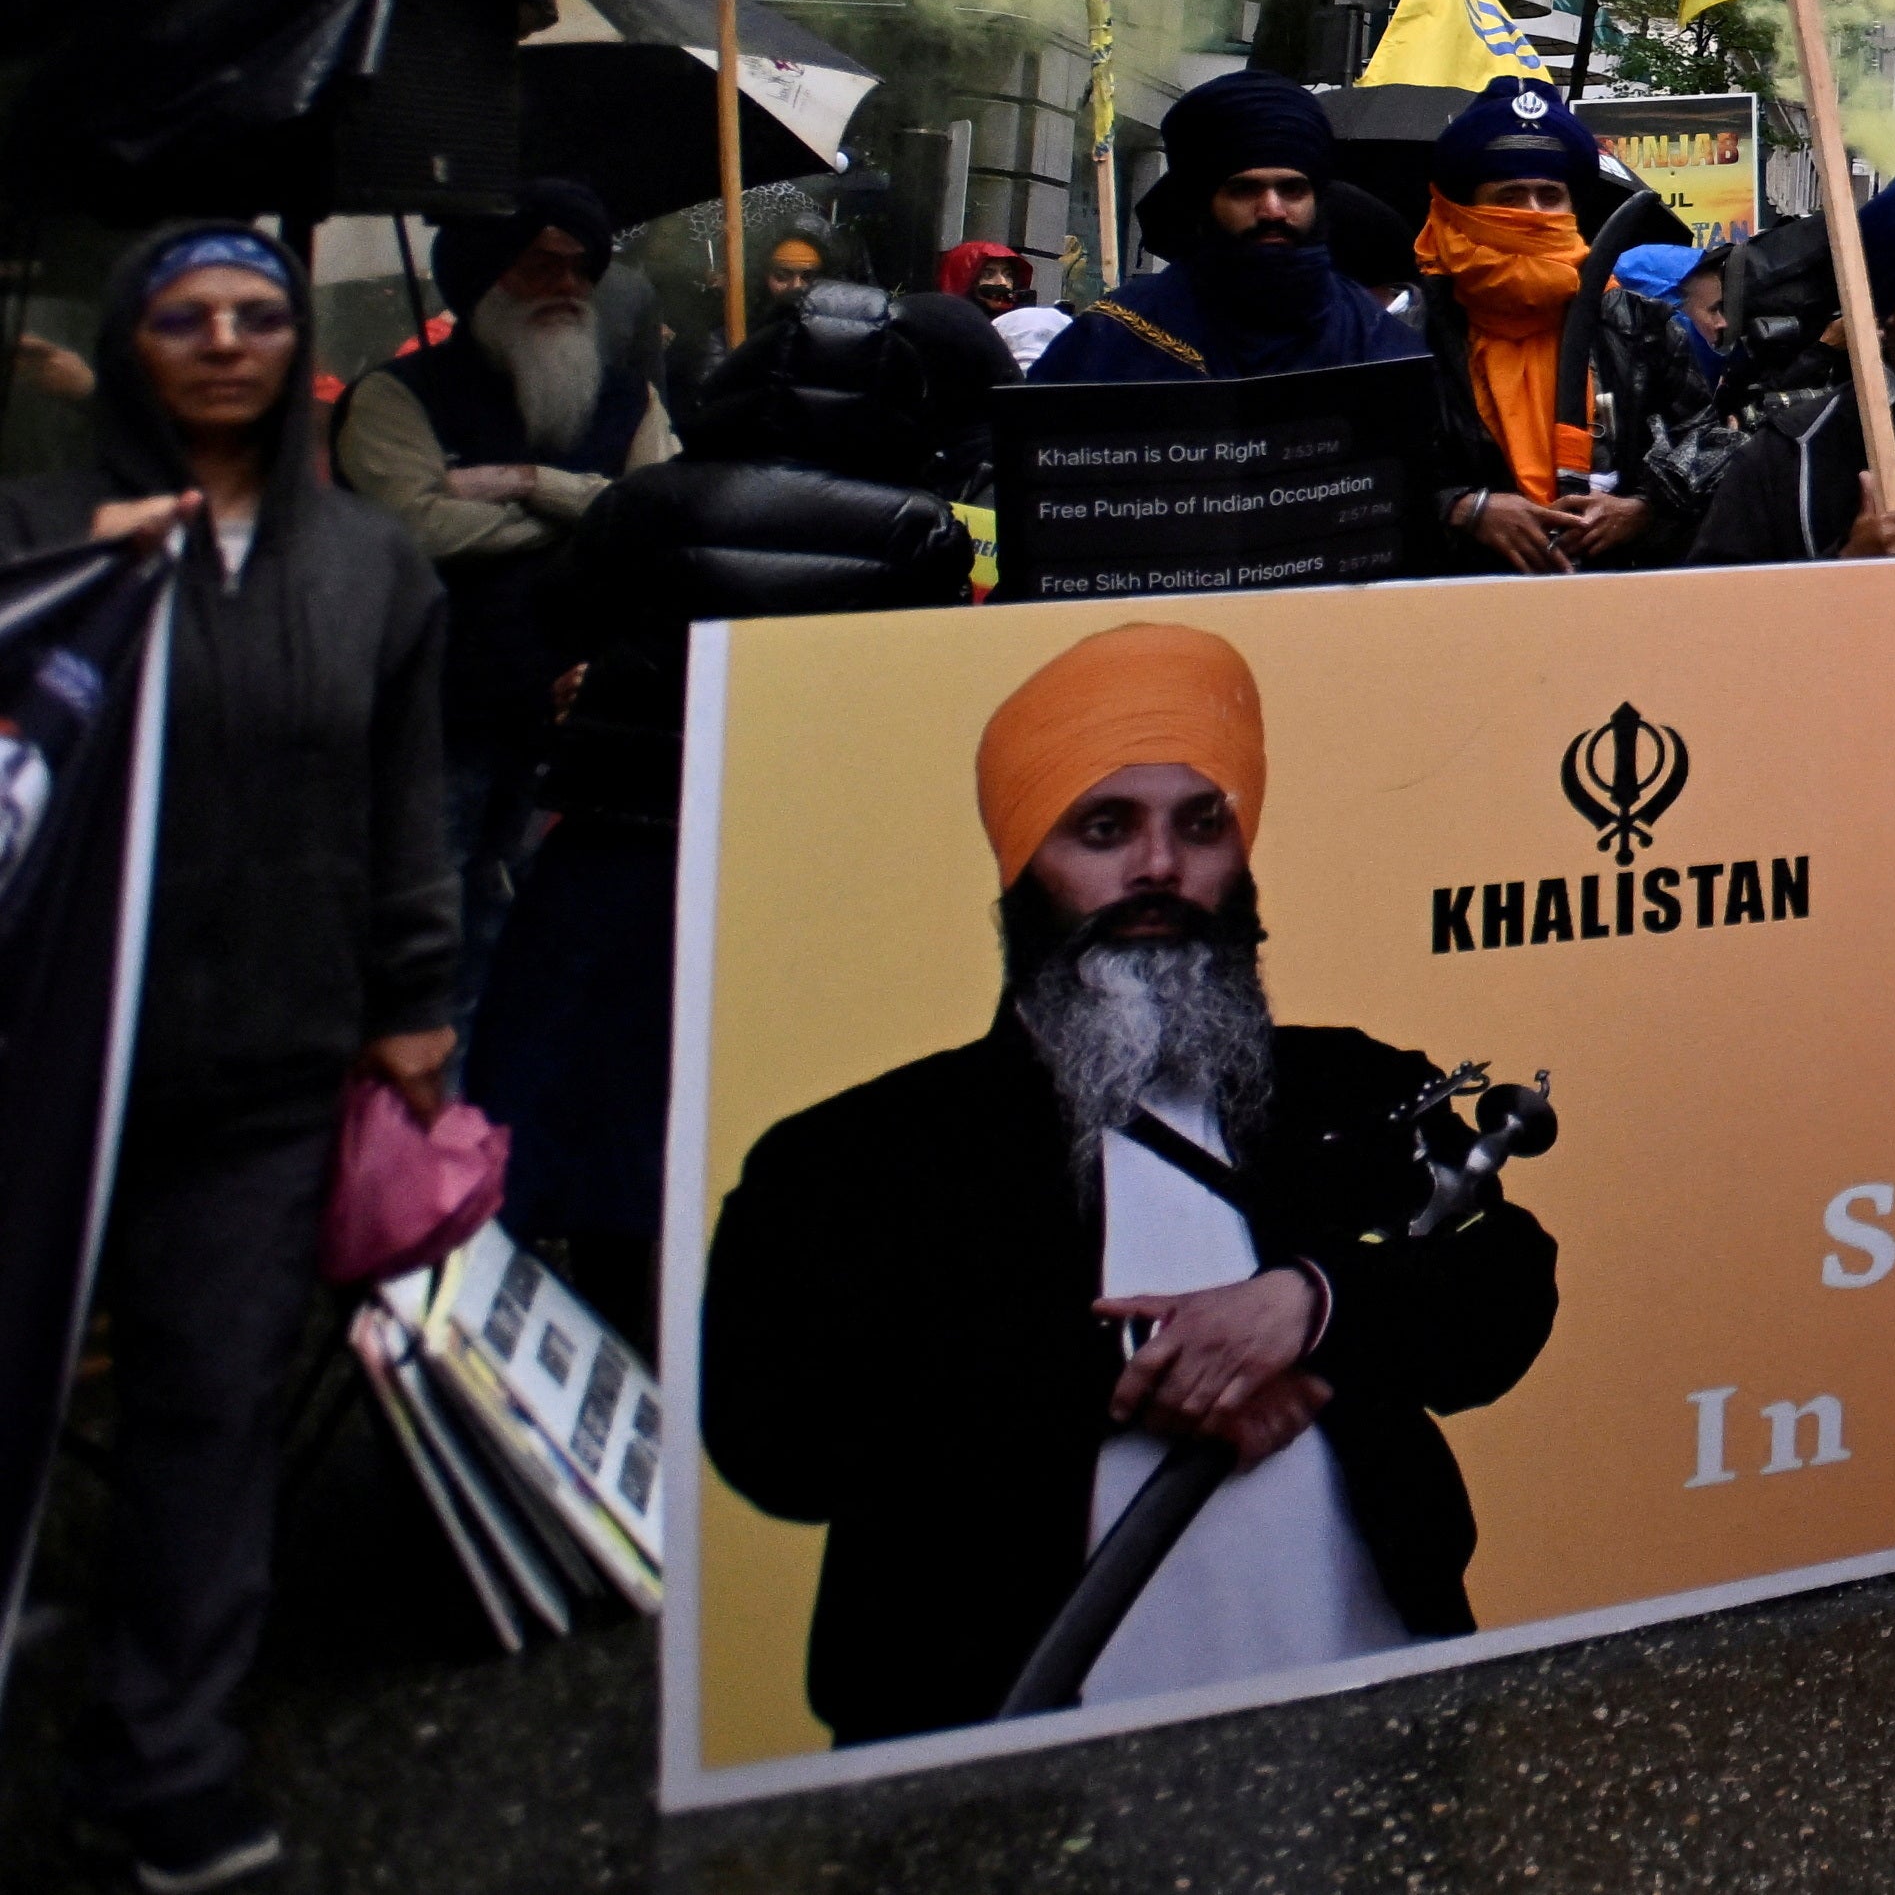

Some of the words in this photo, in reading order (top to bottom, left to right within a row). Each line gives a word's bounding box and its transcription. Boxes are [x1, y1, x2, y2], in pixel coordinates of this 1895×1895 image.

[1038, 447, 1137, 467] Khalistan
[1144, 446, 1161, 463] is
[1168, 444, 1208, 462] Our
[1215, 441, 1267, 465] Right
[1039, 501, 1087, 519] Free
[1094, 499, 1168, 521] Punjab
[1174, 497, 1197, 515] of
[1203, 494, 1264, 514] Indian
[1269, 474, 1373, 507] Occupation
[1041, 576, 1088, 594] Free
[1096, 571, 1141, 592] Sikh
[1148, 568, 1230, 590] Political
[1238, 556, 1324, 584] Prisoners
[1431, 854, 1813, 956] KHALISTAN
[1685, 1380, 1849, 1490] In
